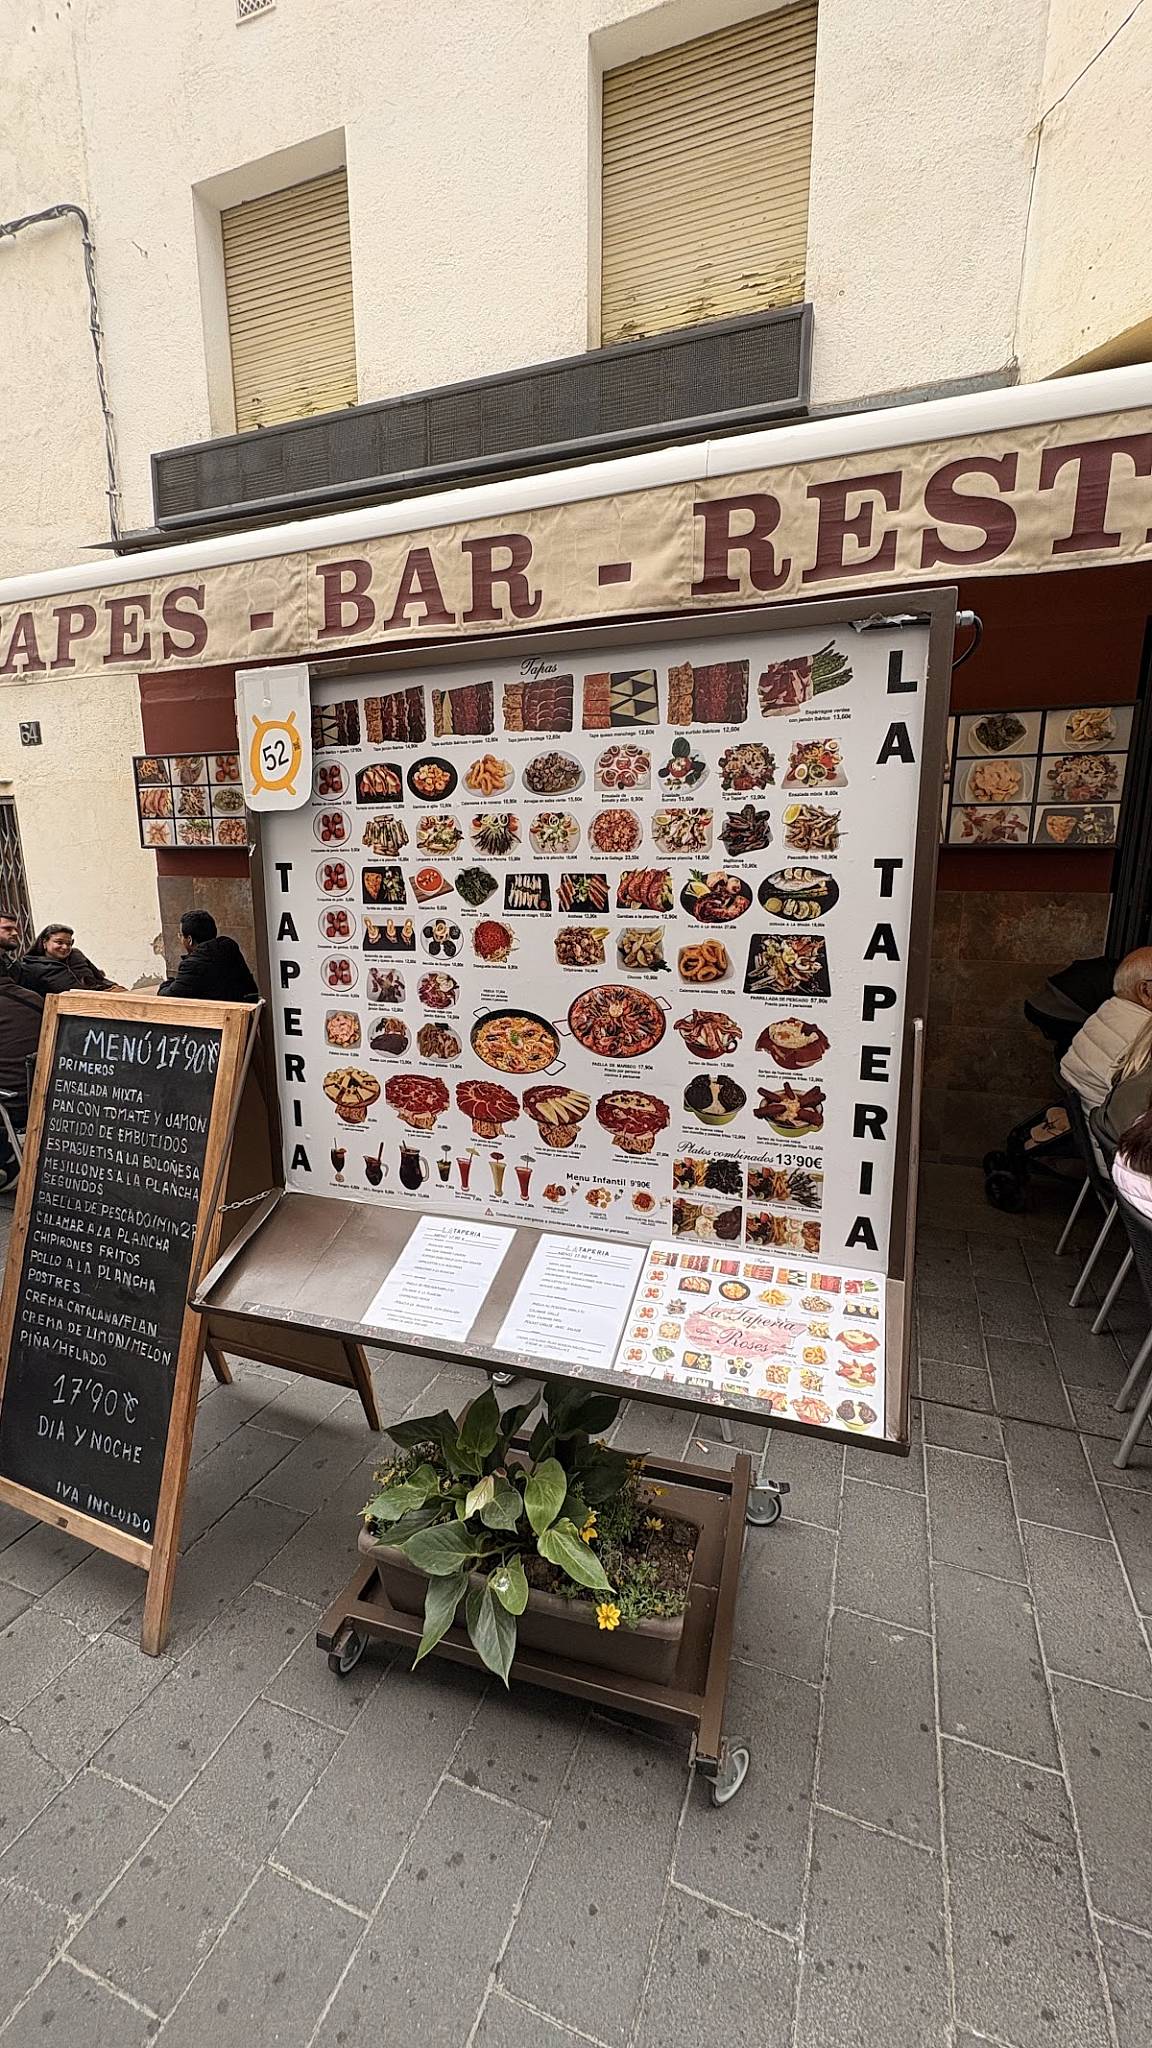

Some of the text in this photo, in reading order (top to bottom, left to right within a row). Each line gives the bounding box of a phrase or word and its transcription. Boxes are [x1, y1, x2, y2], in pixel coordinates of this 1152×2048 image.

[316, 533, 542, 639] BAR
[691, 433, 1152, 596] REST
[520, 657, 558, 680] Tapas
[20, 724, 39, 743] 64
[263, 740, 289, 771] 52
[83, 1028, 152, 1066] MENÚ
[58, 1057, 115, 1076] PRIMEROS
[55, 1079, 144, 1103] ENSALADA MIXTA
[52, 1098, 208, 1133] PAN CON TOMATE Y JAMON
[49, 1118, 188, 1154] SURTIDO DE EMBUTIDOS
[46, 1138, 113, 1160] ESPAGUETIS
[125, 1152, 139, 1166] LA
[143, 1155, 200, 1181] BOLOÑESA
[677, 1142, 823, 1169] Platos combinados 13'90€
[43, 1173, 104, 1195] SEGUNDOS
[126, 1171, 141, 1188] LA
[145, 1176, 199, 1201] PLANCHA
[566, 1173, 651, 1189] Menu Infantil 9'90€
[38, 1190, 82, 1211] PAELLA
[84, 1199, 97, 1216] DE
[36, 1211, 170, 1254] CALAMAR A LA PLANCHA
[453, 1228, 481, 1238] TAPERIA
[33, 1230, 141, 1266] CHIPIRONES FRITOS
[579, 1246, 609, 1257] TAPERIA
[28, 1268, 81, 1294] POSTRES
[30, 1250, 157, 1294] POLLO A LA PLANCHA
[25, 1288, 158, 1338] CREMA CATALANA/FLAN
[699, 1301, 721, 1318] La
[22, 1309, 171, 1366] CREMA DE LIMON/MELON
[716, 1328, 768, 1352] Roses
[38, 1414, 142, 1464] DIA Y NOCHE
[56, 1480, 151, 1533] IVA INCLUIDO
